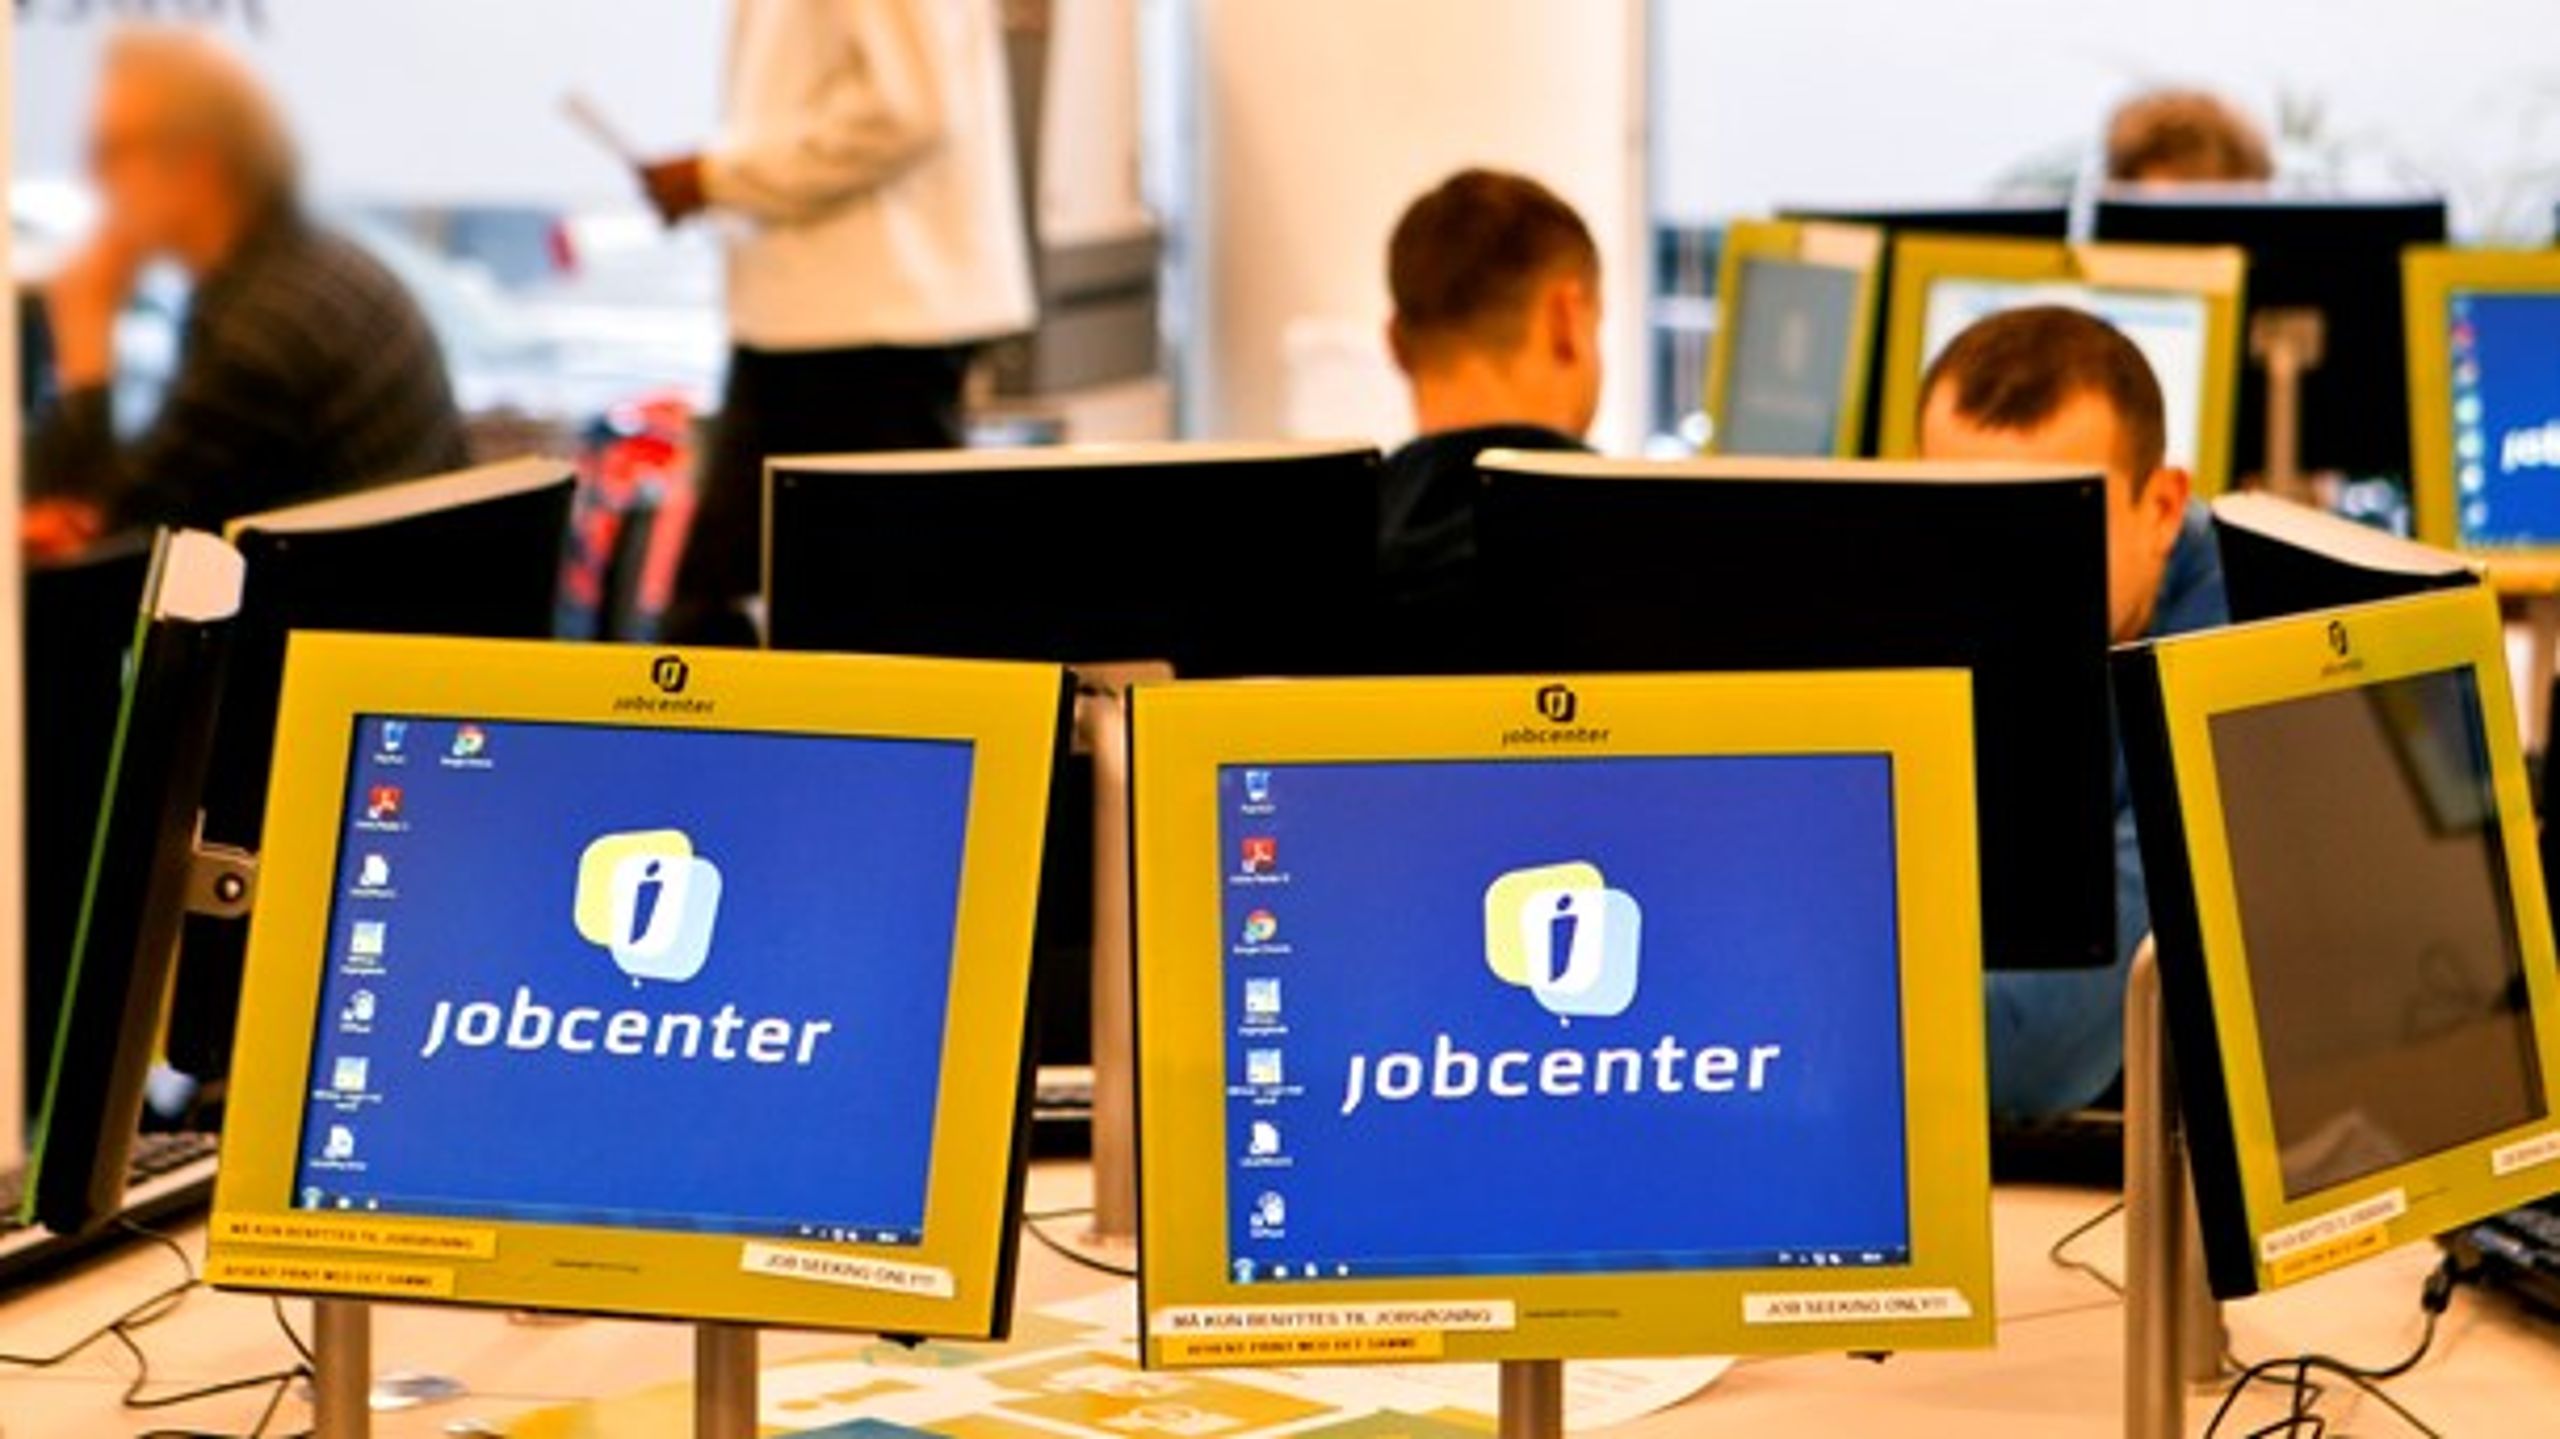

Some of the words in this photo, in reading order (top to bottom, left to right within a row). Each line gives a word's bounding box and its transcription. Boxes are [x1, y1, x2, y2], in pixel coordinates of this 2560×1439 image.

[1502, 726, 1610, 748] jobcenter
[420, 985, 833, 1065] jobcenter
[1340, 1034, 1781, 1116] jobcenter
[766, 1253, 798, 1270] JOB
[801, 1256, 870, 1280] SEEKING
[1767, 1301, 1801, 1315] JOB
[1804, 1299, 1882, 1315] SEEKING
